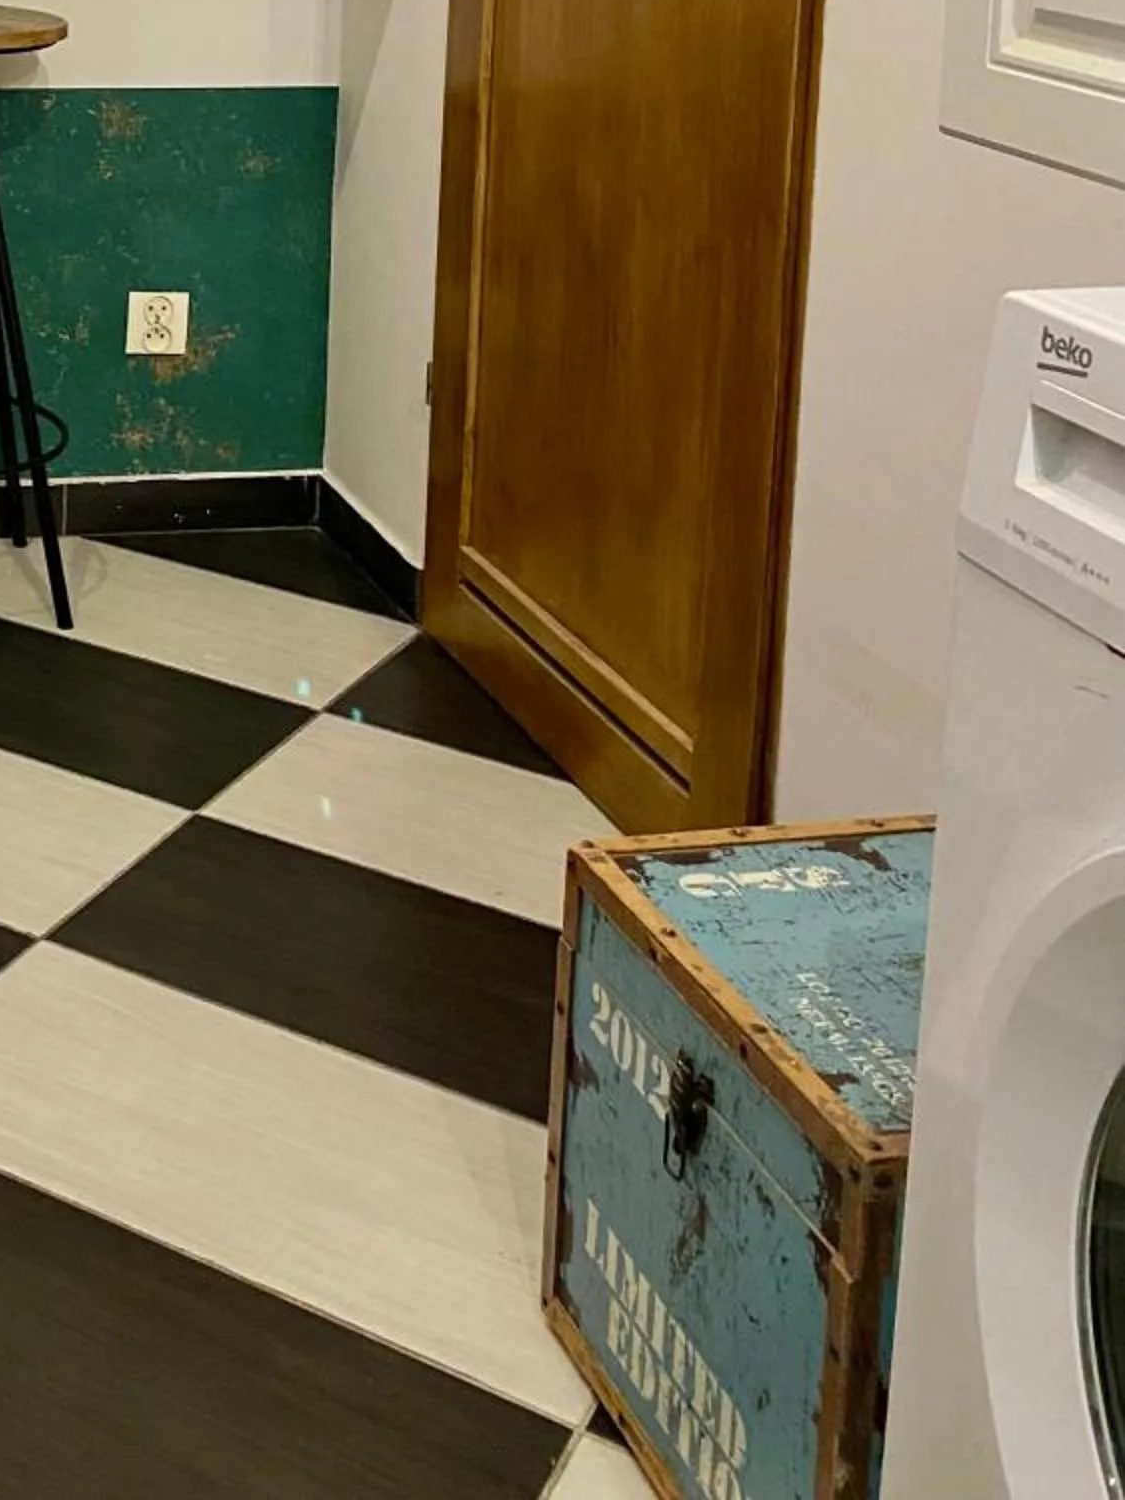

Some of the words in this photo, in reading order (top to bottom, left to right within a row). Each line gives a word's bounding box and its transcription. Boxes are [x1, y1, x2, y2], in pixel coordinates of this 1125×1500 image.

[1041, 325, 1092, 369] beko
[589, 981, 671, 1122] 2012
[584, 1197, 747, 1471] LIMITED
[607, 1296, 752, 1500] EDITIO
